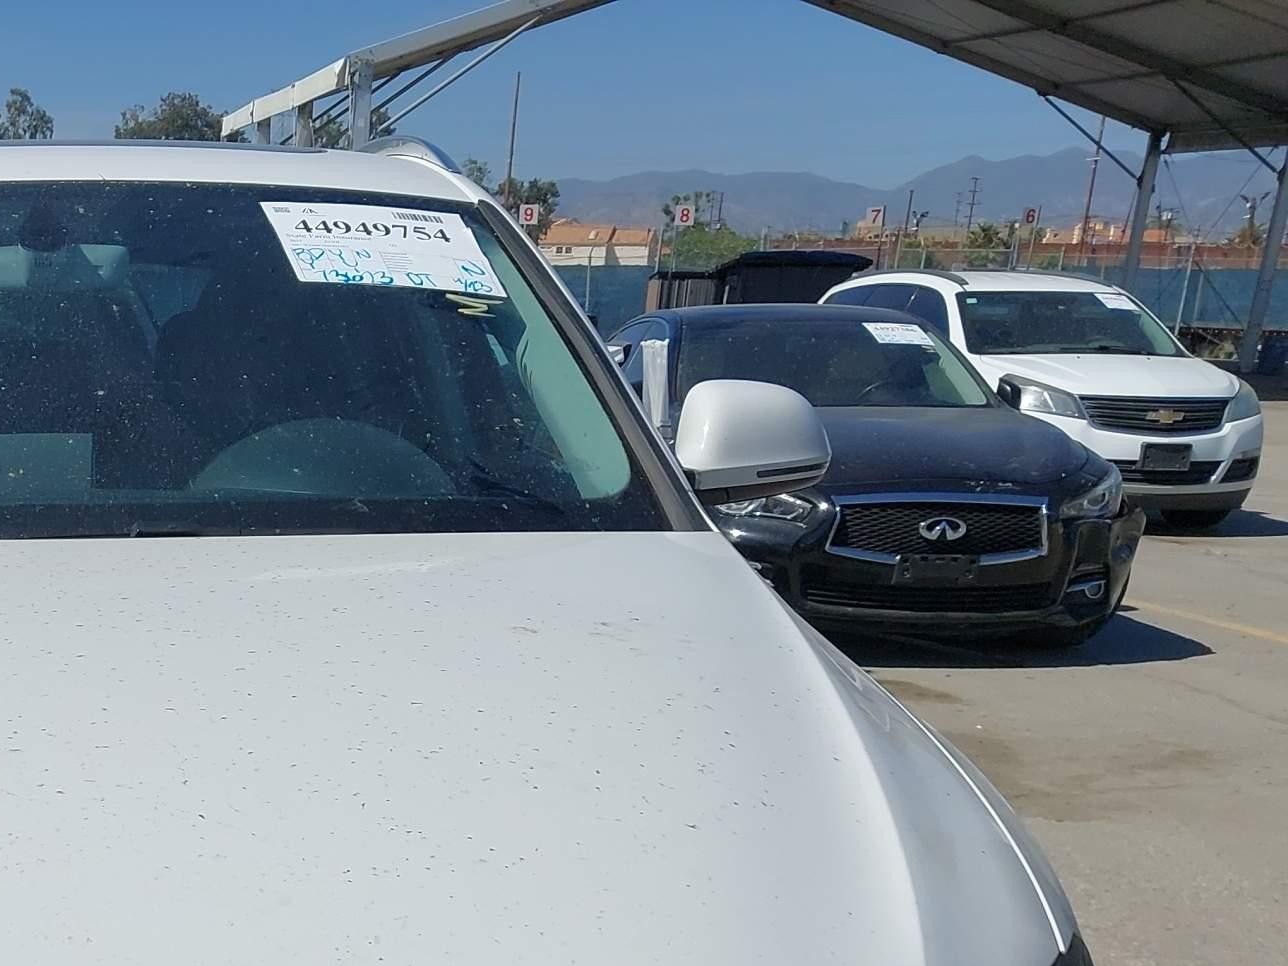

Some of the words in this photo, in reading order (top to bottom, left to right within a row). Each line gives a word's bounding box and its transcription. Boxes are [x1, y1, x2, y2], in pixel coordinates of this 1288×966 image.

[523, 207, 534, 222] 9
[679, 207, 691, 223] 8
[871, 209, 882, 224] 7
[1025, 209, 1036, 224] 6
[294, 218, 451, 244] 44949754
